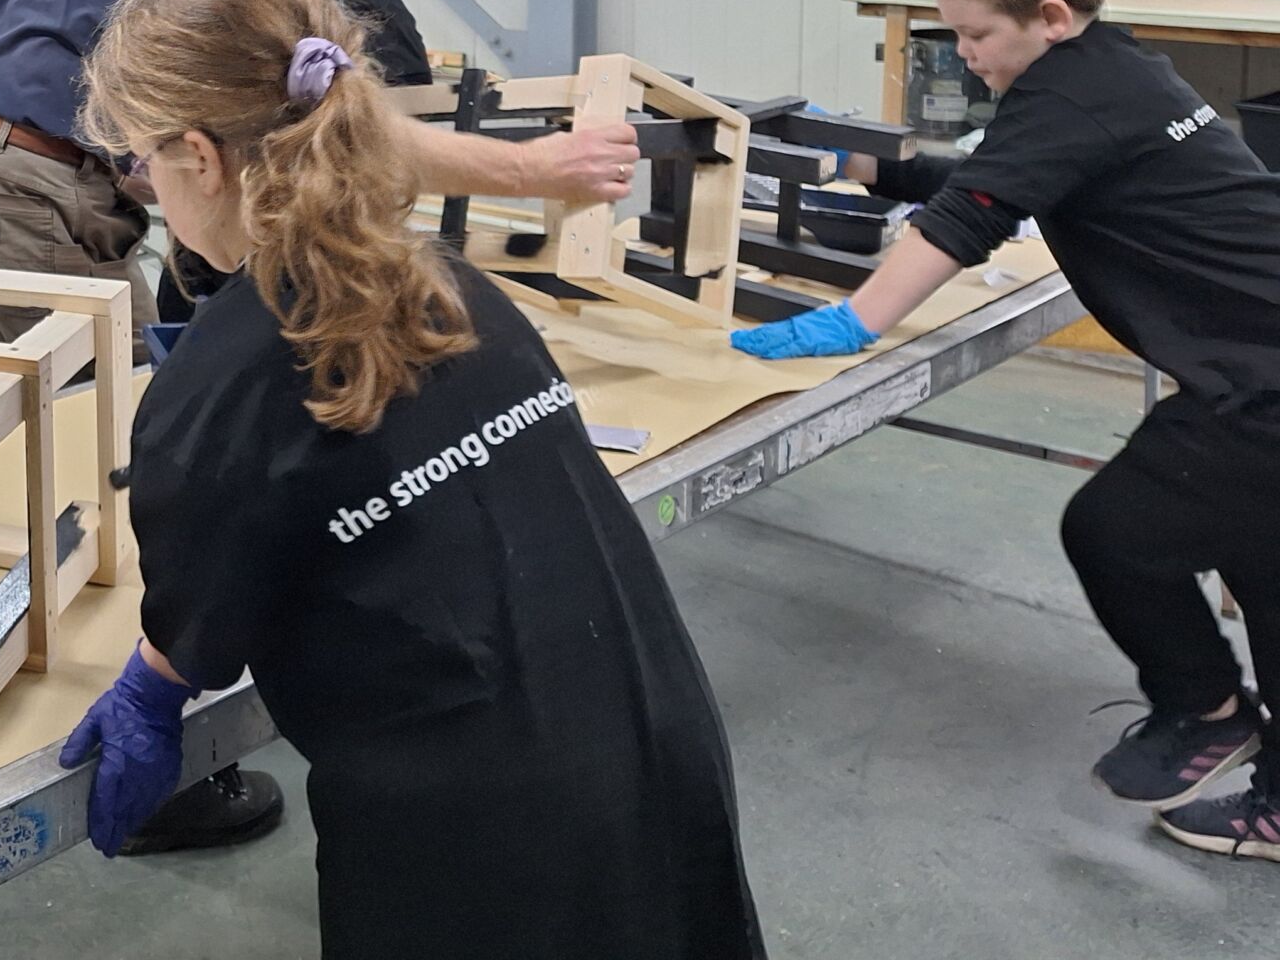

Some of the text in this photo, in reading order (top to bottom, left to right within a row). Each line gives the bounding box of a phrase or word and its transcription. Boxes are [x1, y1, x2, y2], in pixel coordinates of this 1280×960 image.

[1167, 120, 1198, 142] the
[328, 496, 391, 543] the
[389, 432, 490, 507] strong
